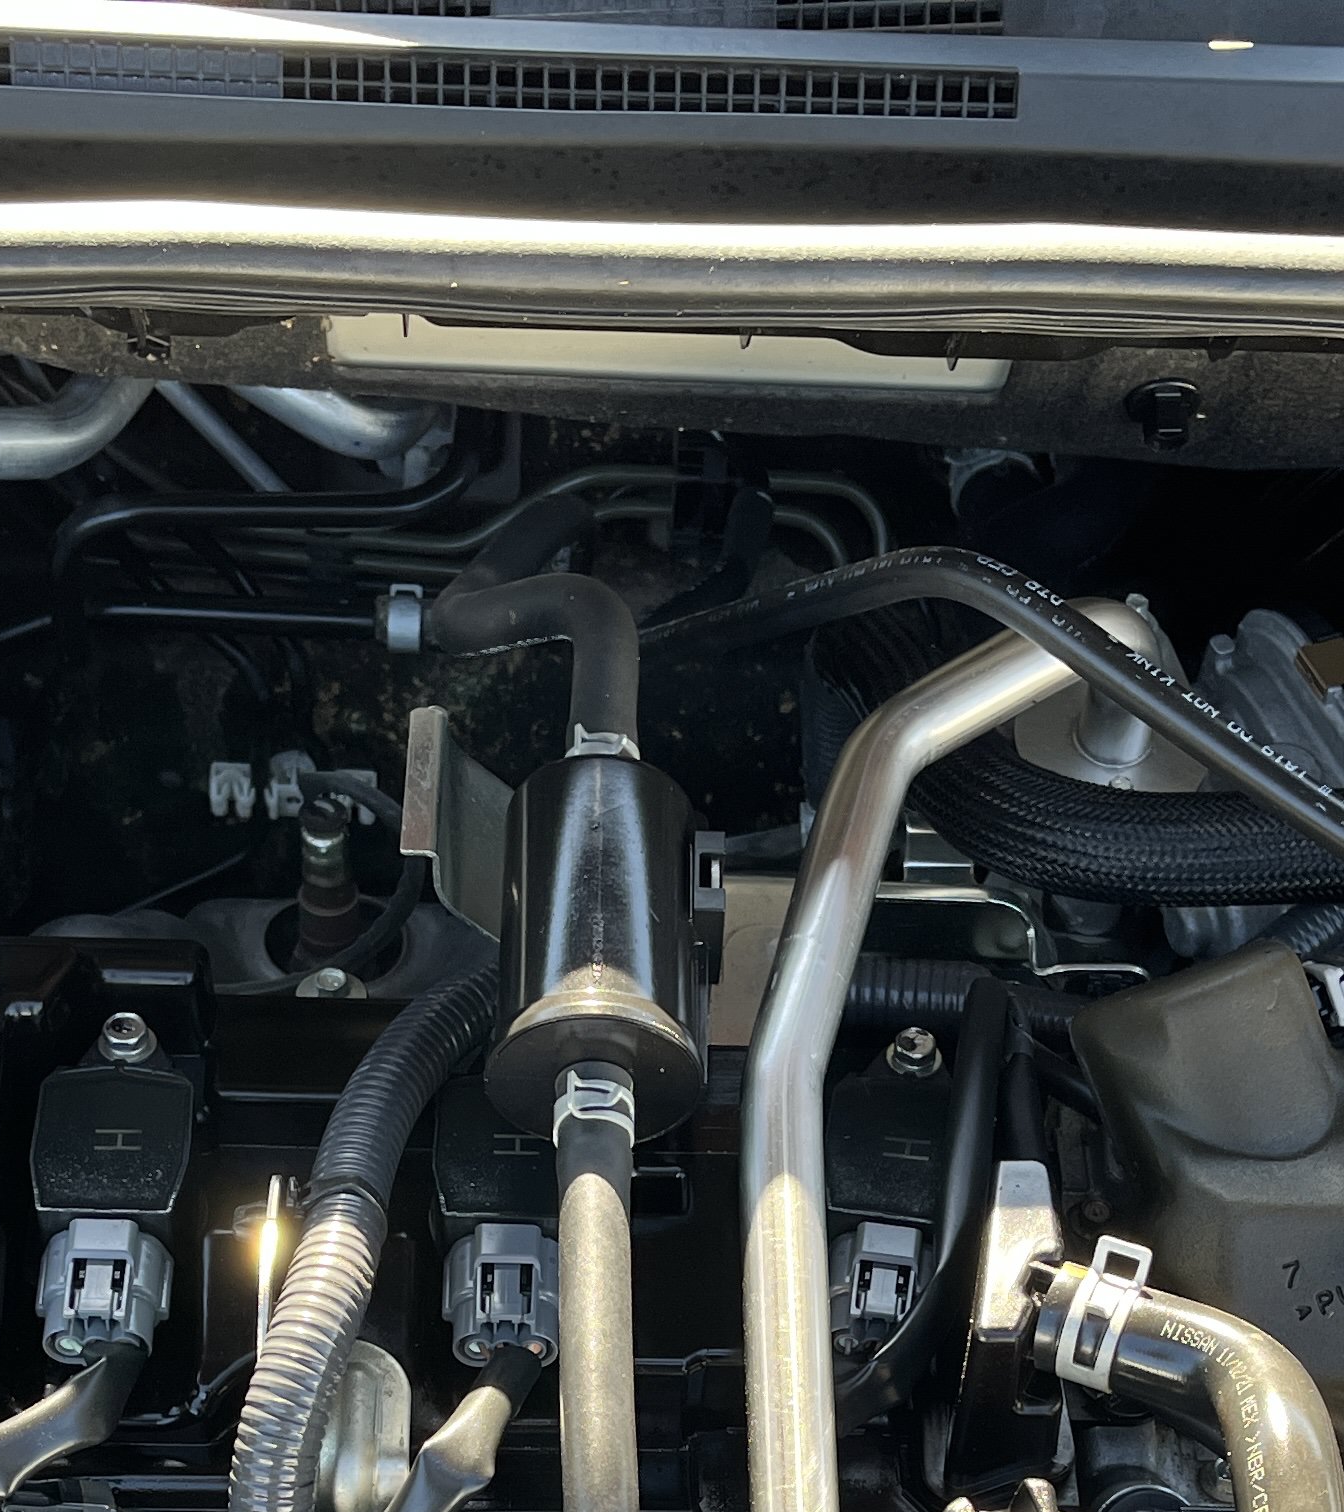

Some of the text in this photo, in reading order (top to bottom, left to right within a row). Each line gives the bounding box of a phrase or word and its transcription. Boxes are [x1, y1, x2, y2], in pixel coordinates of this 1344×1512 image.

[1282, 1259, 1300, 1289] 7
[1159, 1320, 1219, 1356] NISSAN
[1240, 1395, 1260, 1428] MEX
